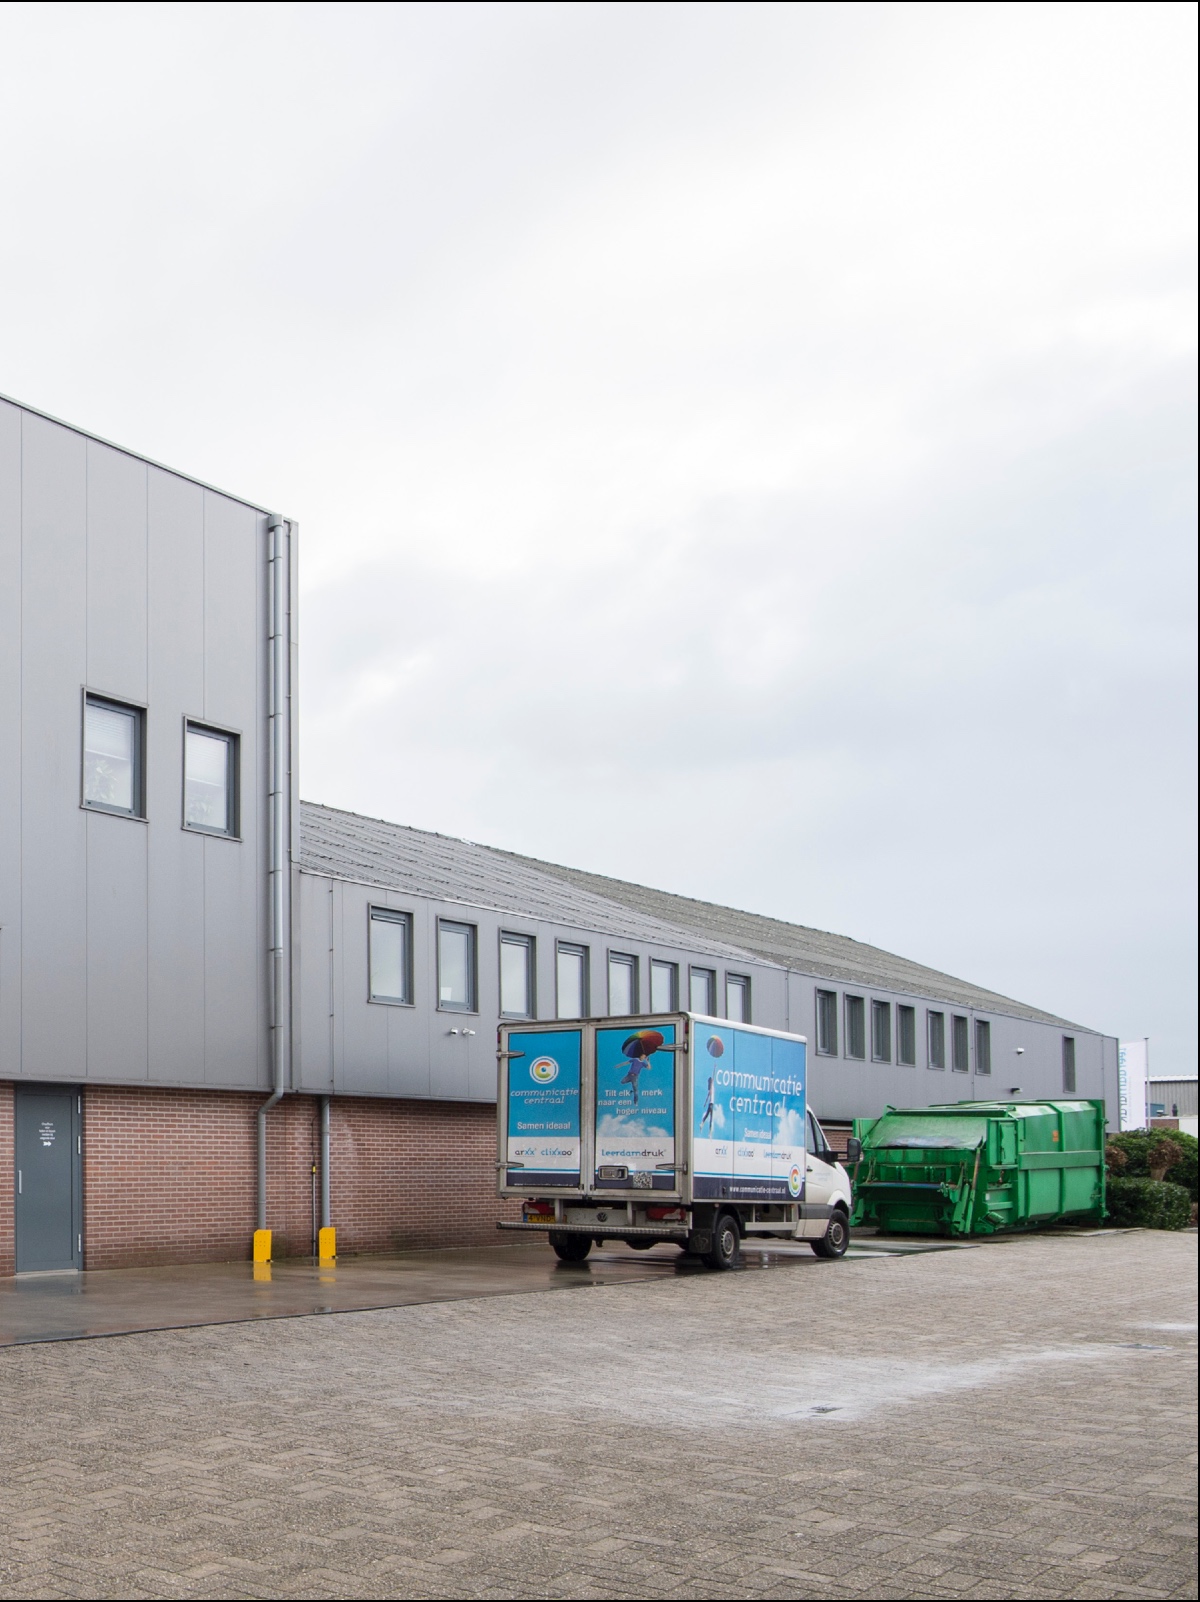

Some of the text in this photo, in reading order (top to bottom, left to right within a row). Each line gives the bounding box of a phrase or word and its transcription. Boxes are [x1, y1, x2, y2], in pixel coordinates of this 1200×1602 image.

[715, 1069, 802, 1097] communicatie
[510, 1088, 579, 1097] communicatie
[605, 1088, 663, 1097] Tilt elk merk
[523, 1096, 565, 1105] centraal
[729, 1093, 786, 1118] centraal
[616, 1107, 639, 1116] hoger
[517, 1121, 571, 1130] Samen ideaal
[601, 1148, 665, 1157] leerdamdruk
